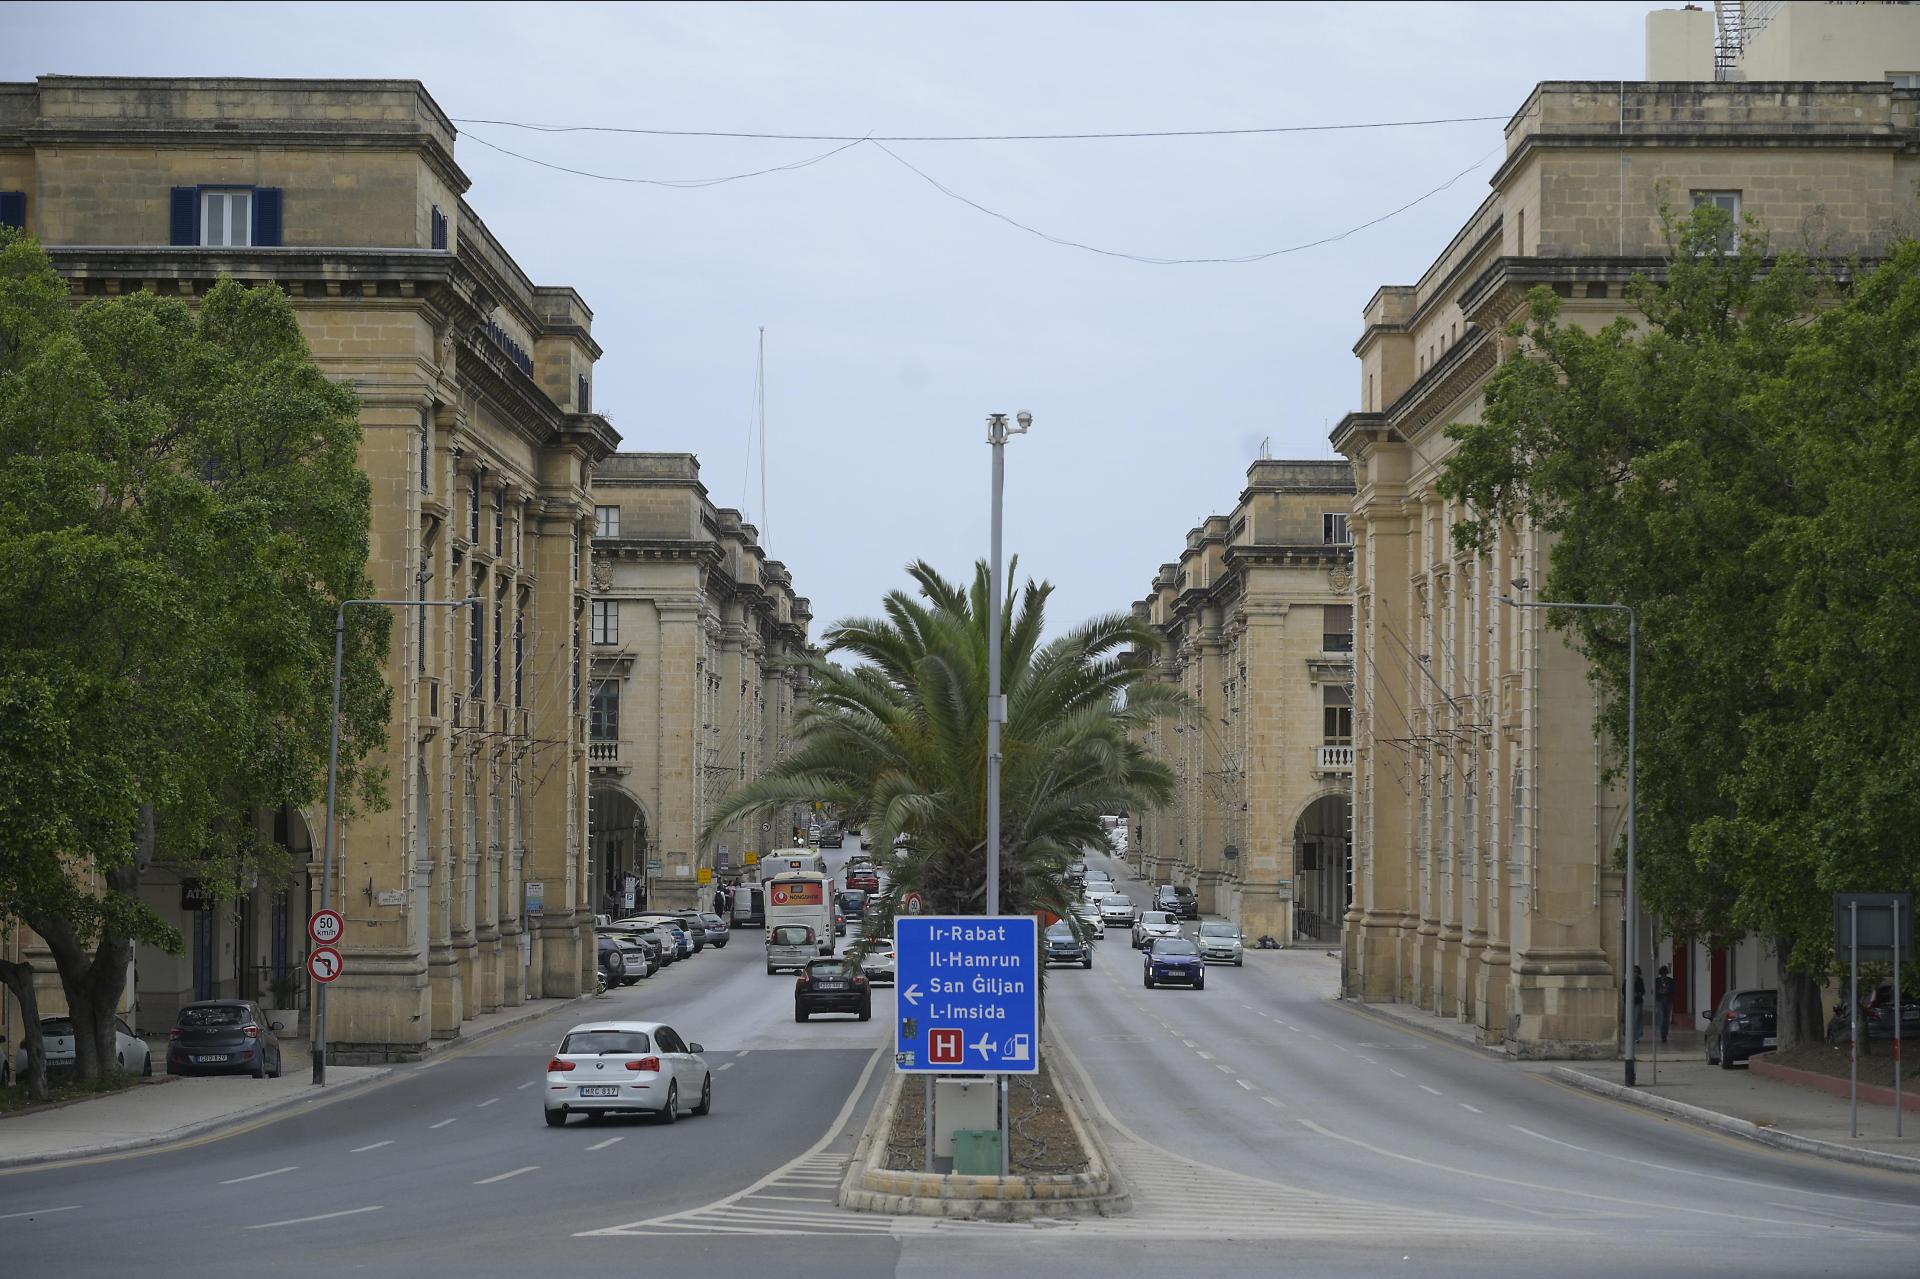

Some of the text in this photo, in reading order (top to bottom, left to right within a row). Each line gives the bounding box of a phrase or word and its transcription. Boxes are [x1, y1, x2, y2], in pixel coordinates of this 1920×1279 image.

[320, 917, 333, 929] 50
[317, 929, 336, 937] km/h
[930, 925, 1006, 941] Ir-Rabat
[930, 951, 1020, 967] Il-Hamrun
[930, 973, 1024, 996] San Ġiljan
[930, 1003, 1006, 1019] L-Imsida
[936, 1034, 955, 1058] H
